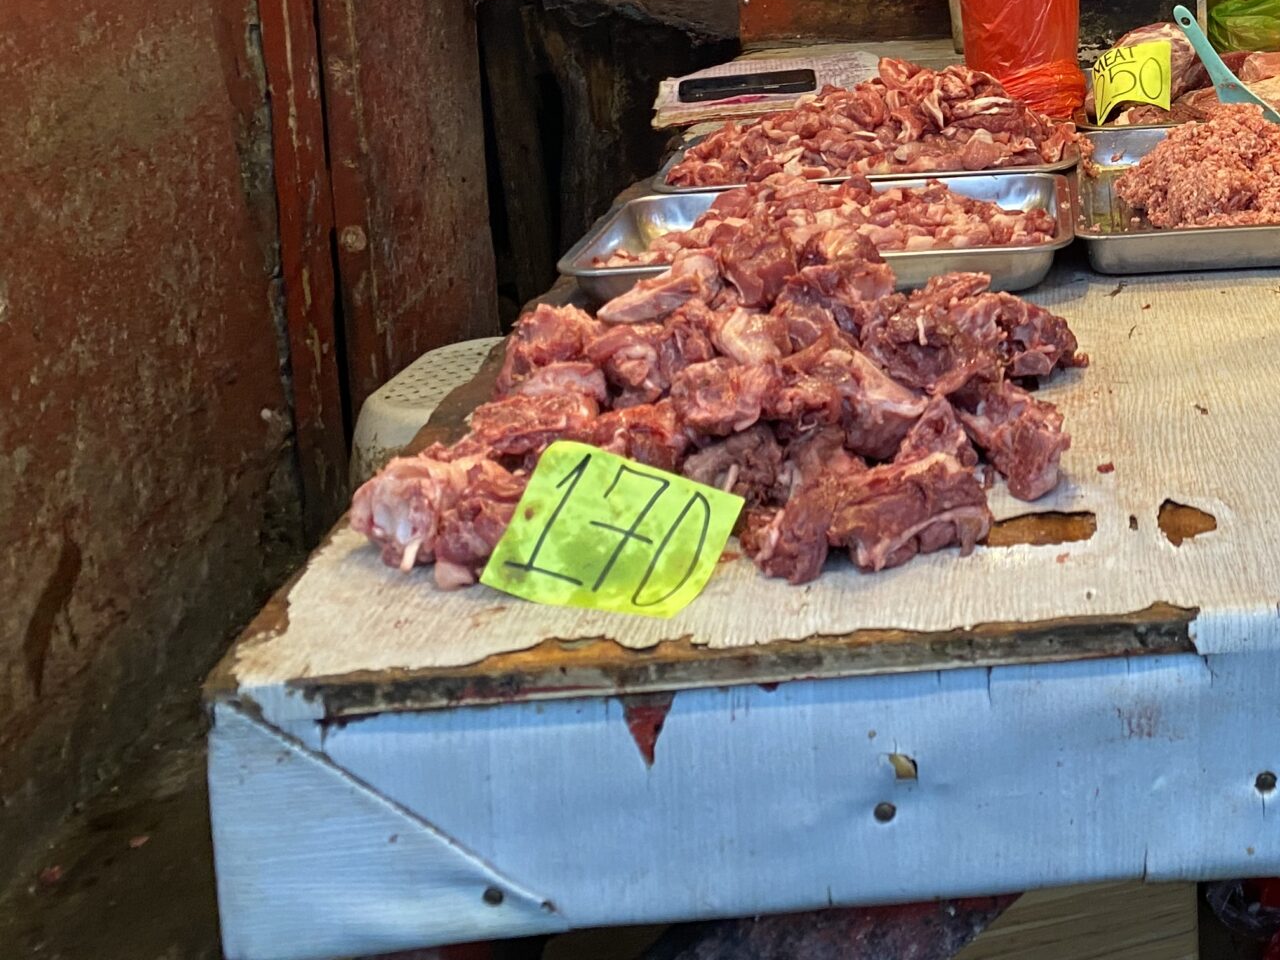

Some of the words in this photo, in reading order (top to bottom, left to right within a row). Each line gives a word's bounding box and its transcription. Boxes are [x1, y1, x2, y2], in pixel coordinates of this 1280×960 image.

[1093, 44, 1138, 80] MEAT
[1095, 57, 1163, 122] 250
[504, 453, 711, 607] 170
